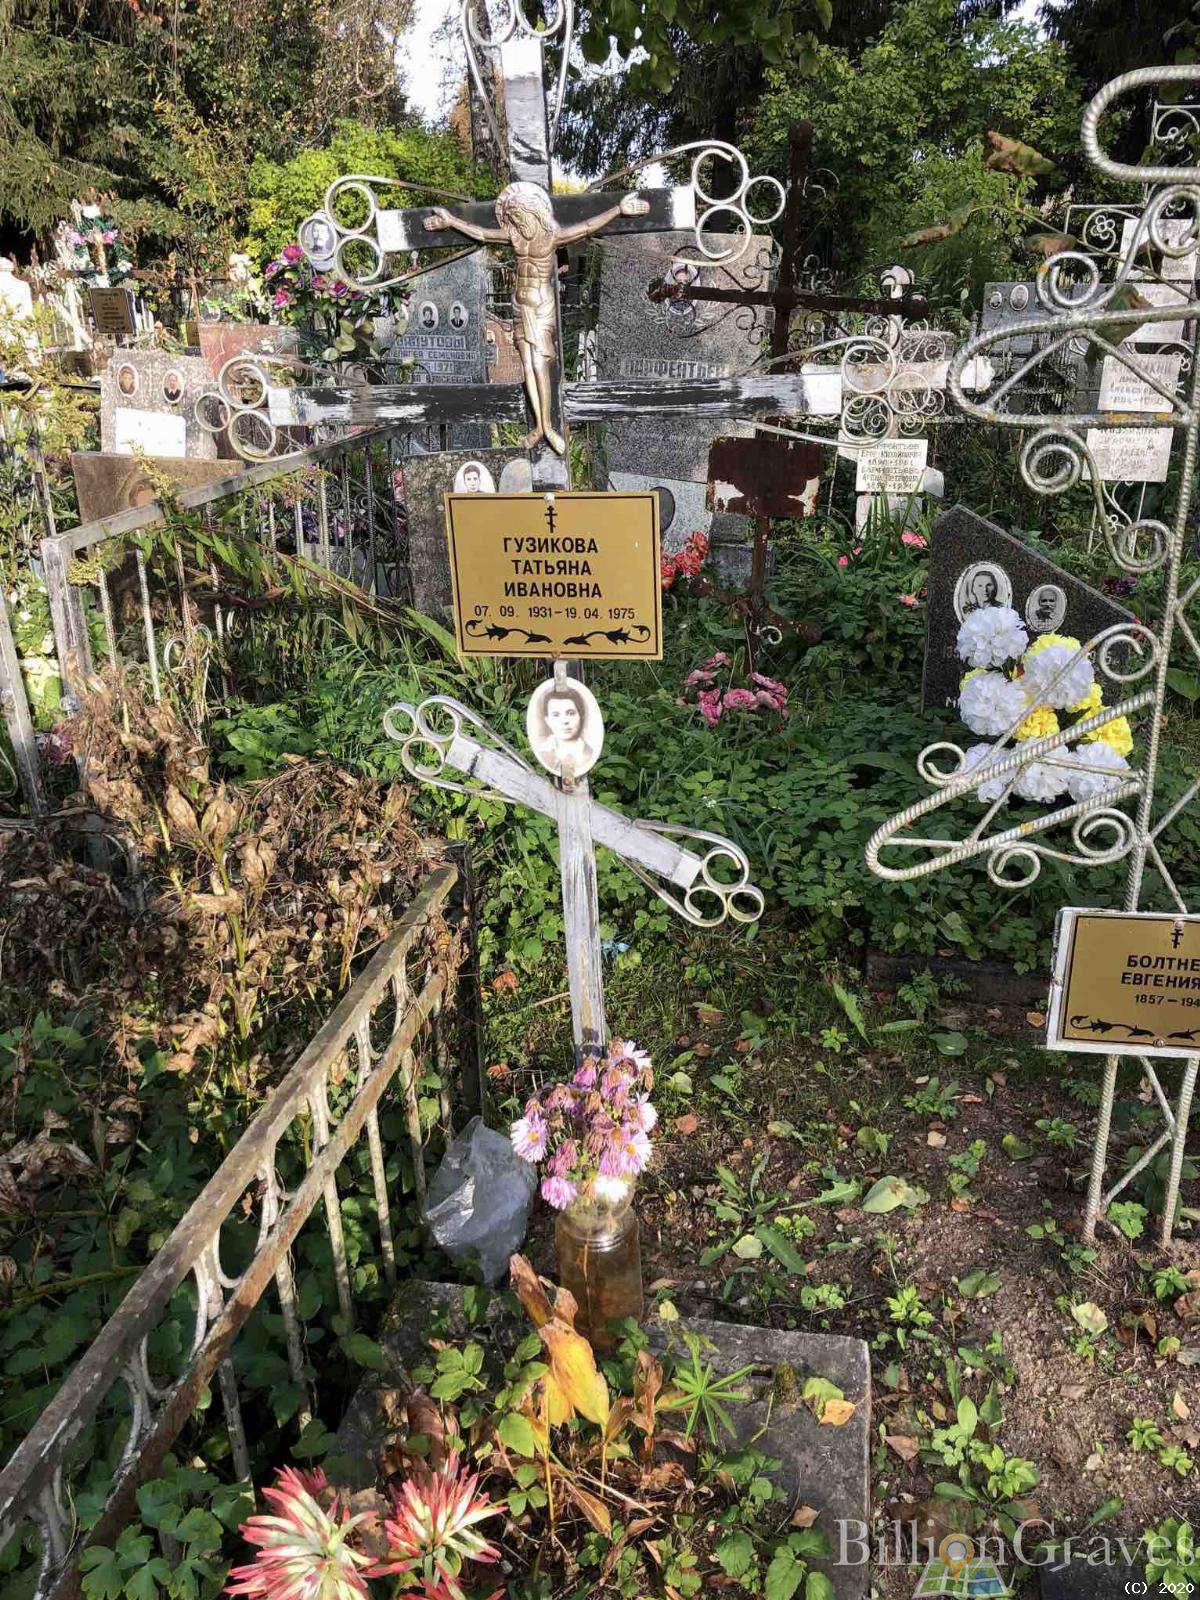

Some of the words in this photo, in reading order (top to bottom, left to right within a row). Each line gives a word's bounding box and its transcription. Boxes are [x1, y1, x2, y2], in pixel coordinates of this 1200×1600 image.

[503, 537, 598, 554] ГУЗИКОВА
[511, 559, 592, 575] ТАТЬЯНА
[504, 582, 602, 598] ИВАНОВНА
[474, 605, 492, 617] 07.
[499, 606, 519, 618] 09.
[608, 608, 635, 620] 1975
[1128, 955, 1200, 971] БОЛТНЕ
[1121, 972, 1200, 988] ЕВГЕНИЯ
